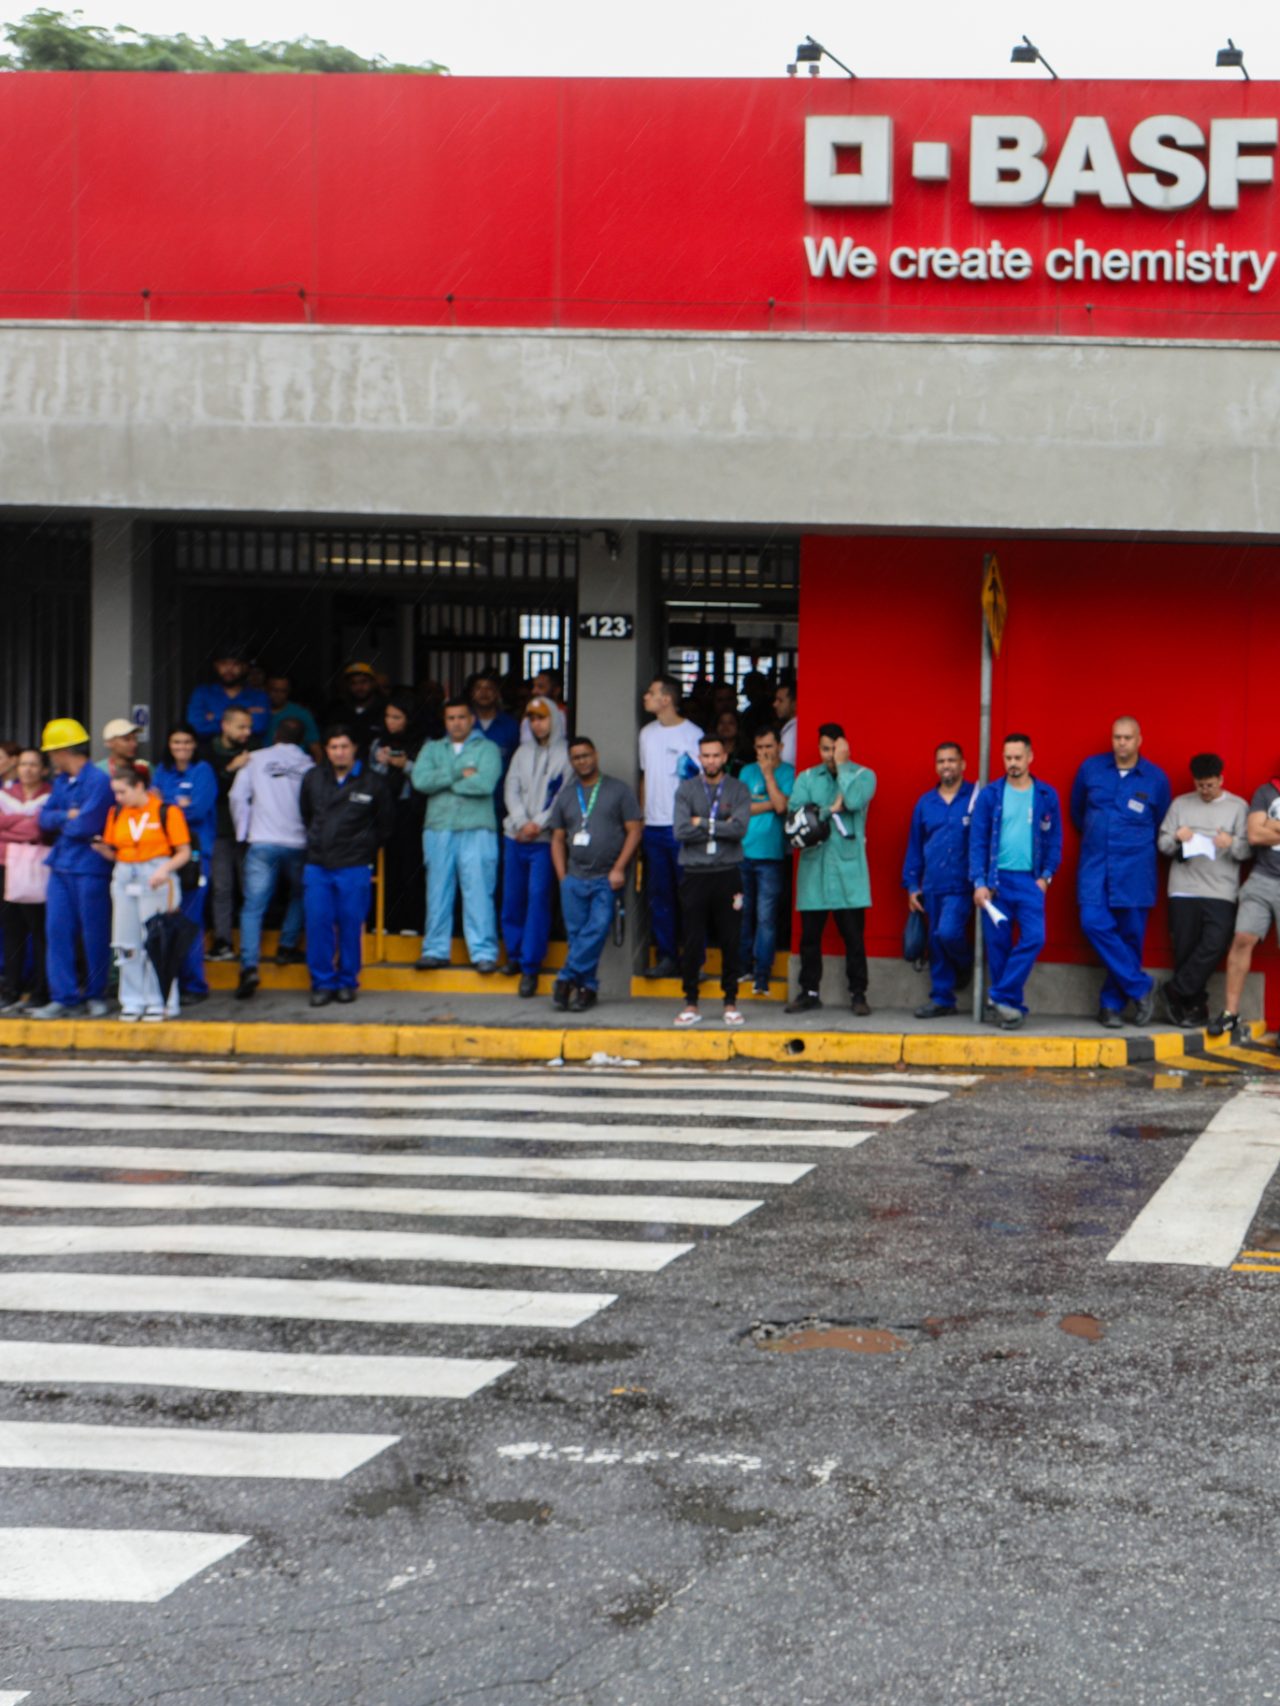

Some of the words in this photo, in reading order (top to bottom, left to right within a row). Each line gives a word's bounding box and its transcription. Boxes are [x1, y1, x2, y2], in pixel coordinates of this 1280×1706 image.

[970, 115, 1278, 210] BASF
[803, 236, 877, 278] We
[890, 239, 1032, 280] create
[1045, 239, 1277, 292] chemistry
[586, 616, 627, 637] 123
